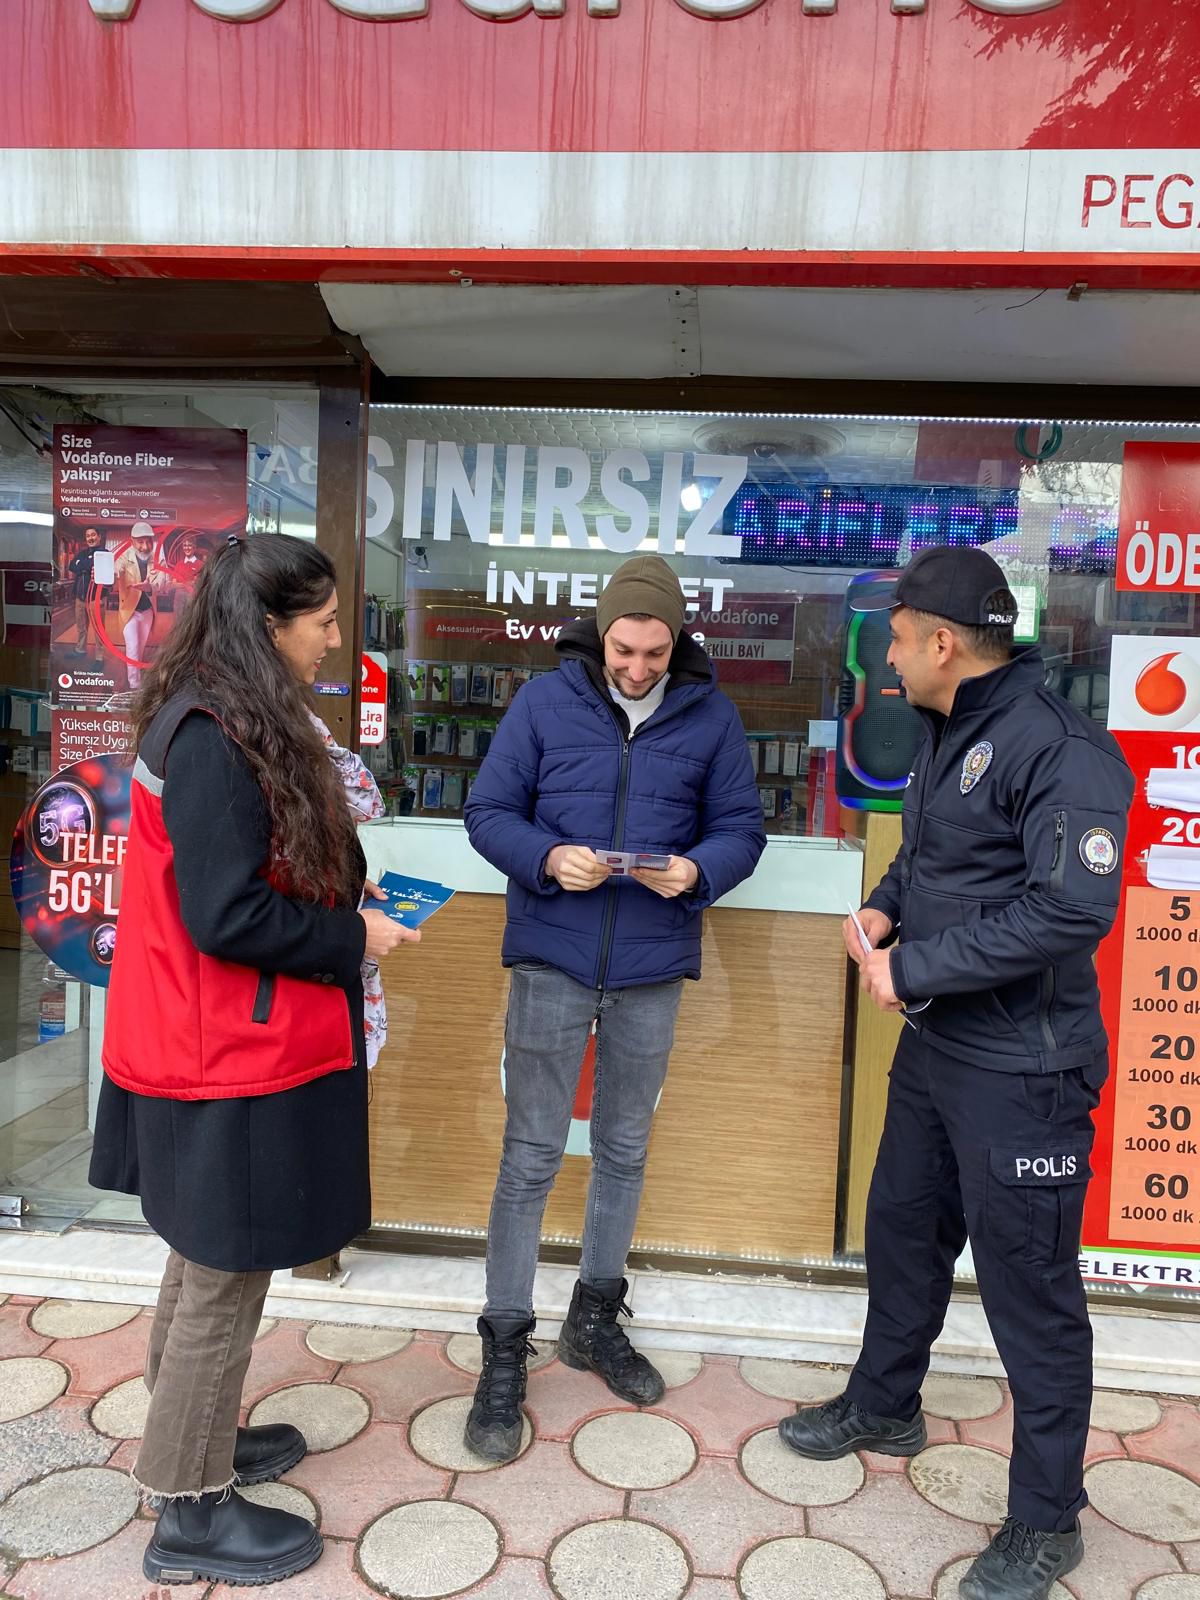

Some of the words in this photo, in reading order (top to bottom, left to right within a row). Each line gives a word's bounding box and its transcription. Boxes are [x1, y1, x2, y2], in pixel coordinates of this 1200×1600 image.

[1081, 173, 1200, 229] PEG
[61, 434, 92, 448] Size
[61, 450, 132, 465] Vodafone
[135, 452, 174, 467] Fiber
[60, 466, 112, 484] yakışır
[486, 561, 735, 612] İNTEET
[701, 609, 779, 625] vodafone
[506, 618, 535, 640] Ev
[738, 642, 765, 658] BAYİ
[74, 677, 115, 687] vodafone
[60, 718, 100, 732] Yüksek
[60, 732, 100, 746] Sınırsız
[60, 748, 83, 760] Size
[1169, 896, 1190, 921] 5
[1136, 926, 1182, 941] 1000
[1188, 929, 1200, 942] d
[1154, 965, 1198, 991] 10
[1132, 997, 1178, 1013] 1000
[1150, 1034, 1195, 1060] 20
[1128, 1068, 1174, 1083] 1000
[1180, 1071, 1200, 1085] dk
[1146, 1104, 1191, 1131] 30
[1124, 1136, 1170, 1152] 1000
[1176, 1140, 1197, 1154] dk
[1144, 1173, 1189, 1199] 60
[1121, 1205, 1167, 1221] 1000
[1172, 1209, 1194, 1223] dk
